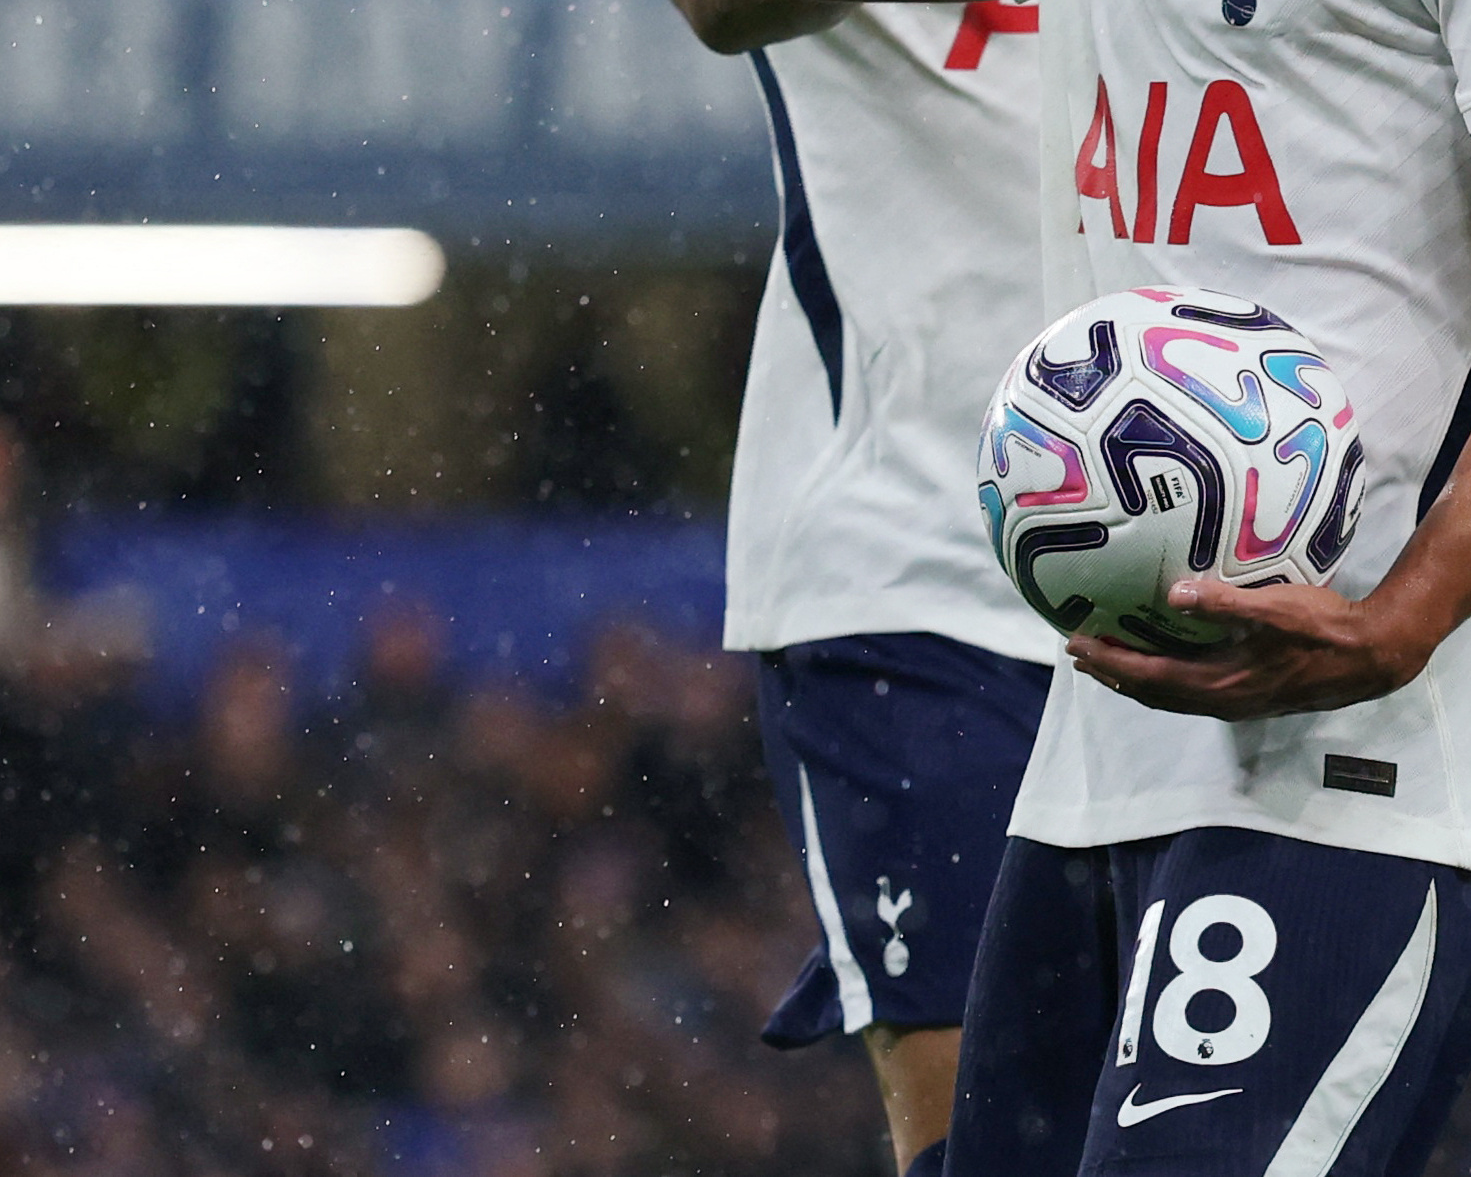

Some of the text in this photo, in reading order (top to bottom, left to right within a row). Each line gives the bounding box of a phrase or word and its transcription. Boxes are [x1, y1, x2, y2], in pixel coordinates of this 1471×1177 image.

[1075, 73, 1303, 246] AIA
[1170, 476, 1184, 499] FIFA
[1115, 894, 1278, 1068] 18
